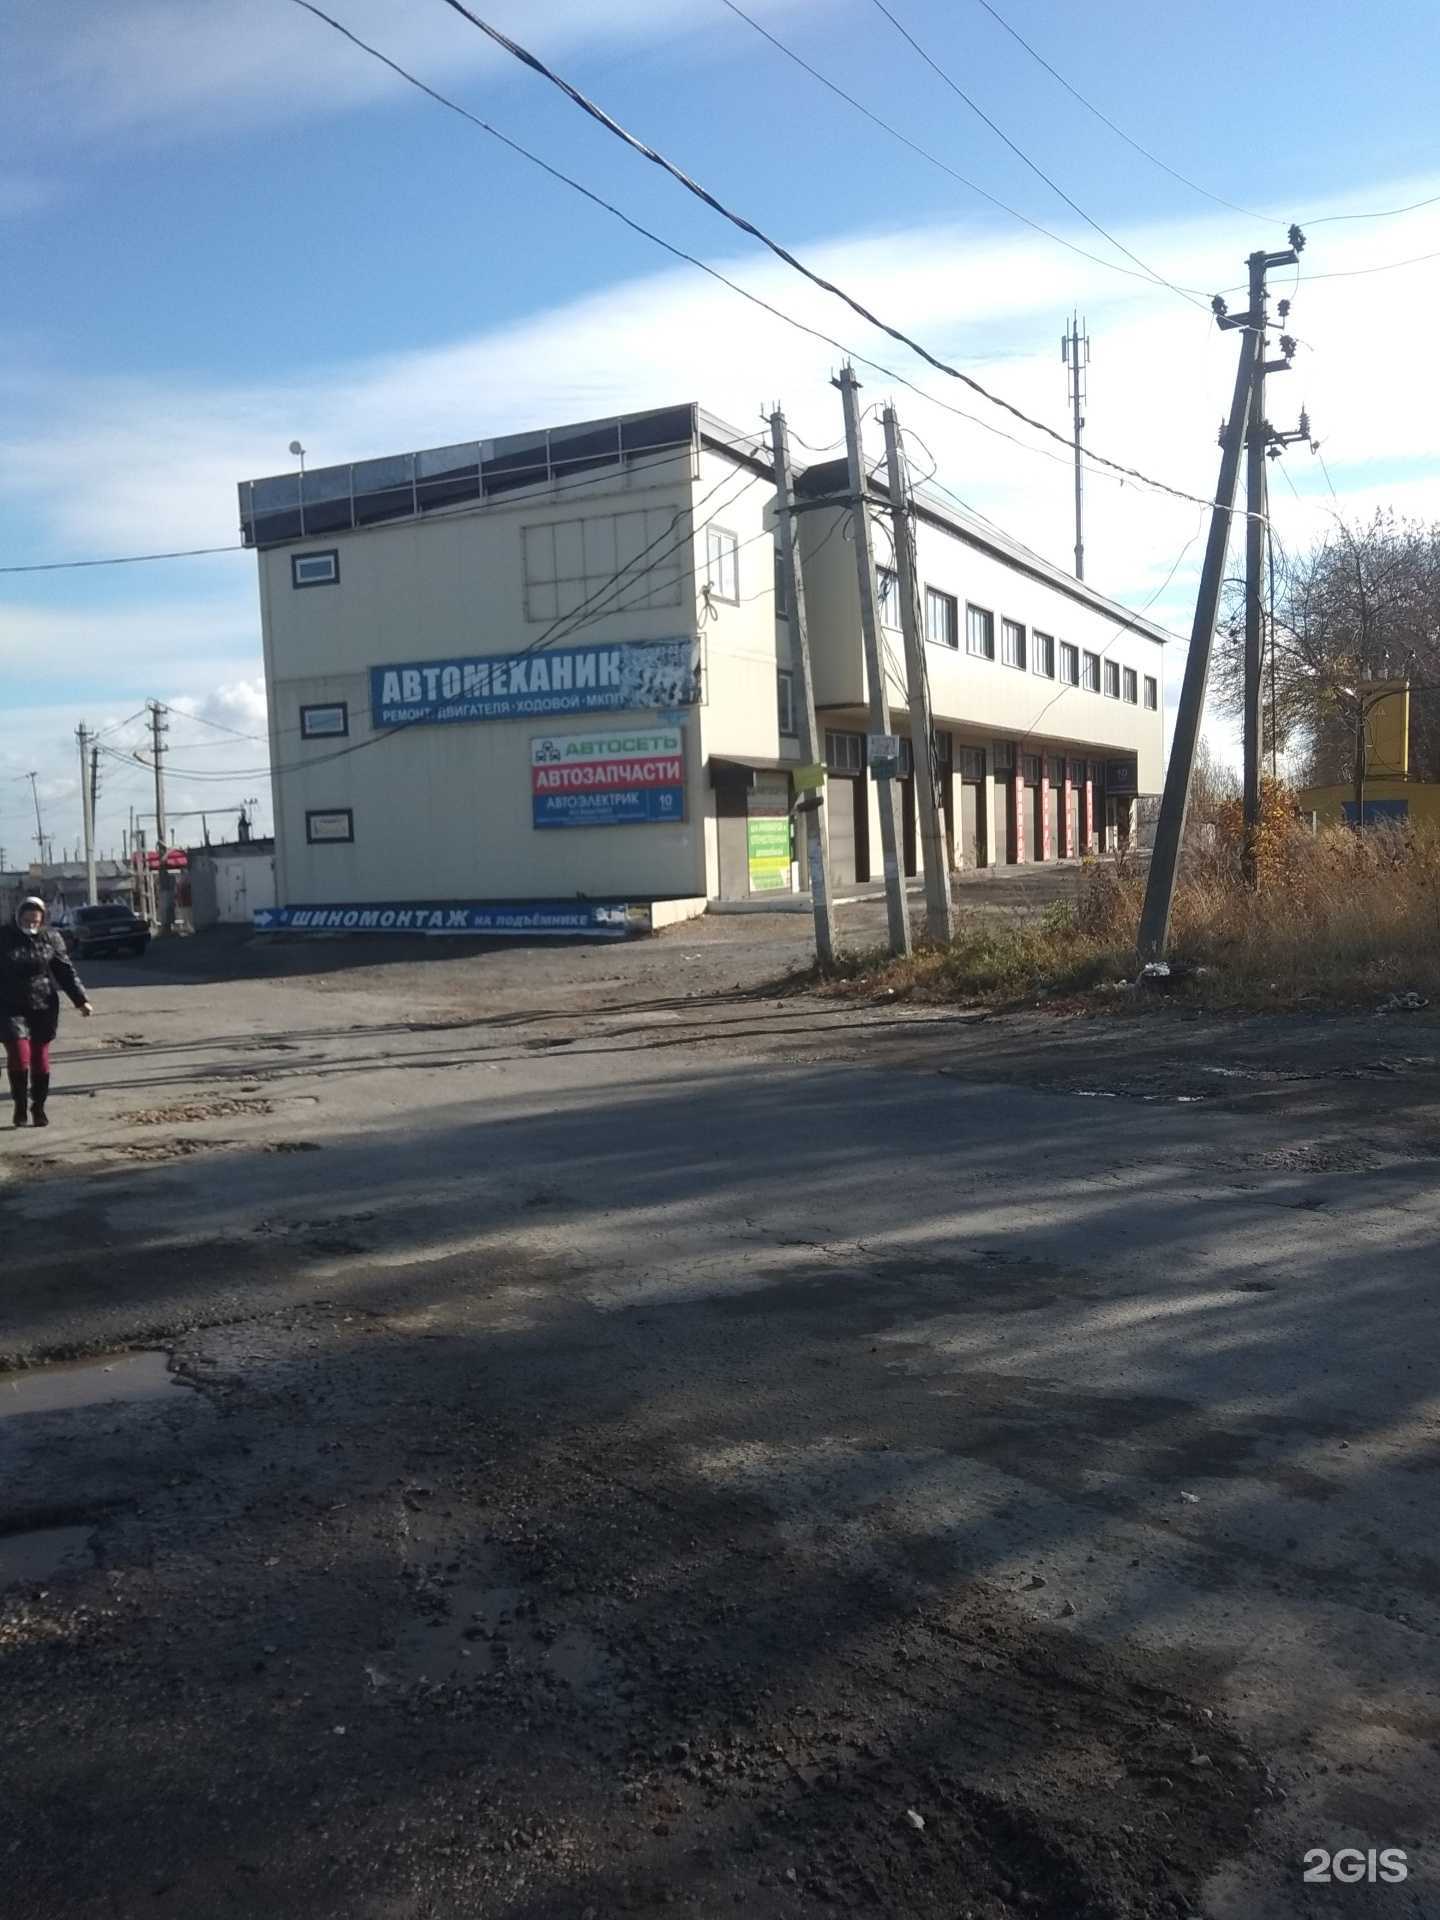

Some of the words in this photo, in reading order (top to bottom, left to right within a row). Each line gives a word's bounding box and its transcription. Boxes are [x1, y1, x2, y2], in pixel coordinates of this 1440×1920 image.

[382, 651, 621, 704] АВТОМЕХАНИК
[517, 695, 580, 713] ХОДОВОЙ
[566, 736, 678, 756] АВТОСЕТЬ
[536, 761, 681, 788] АВТОЗАПЧАСТИ
[547, 792, 639, 810] АВТОЭЛЕКТРИК
[291, 908, 470, 928] ШИНОМОНТАЖ
